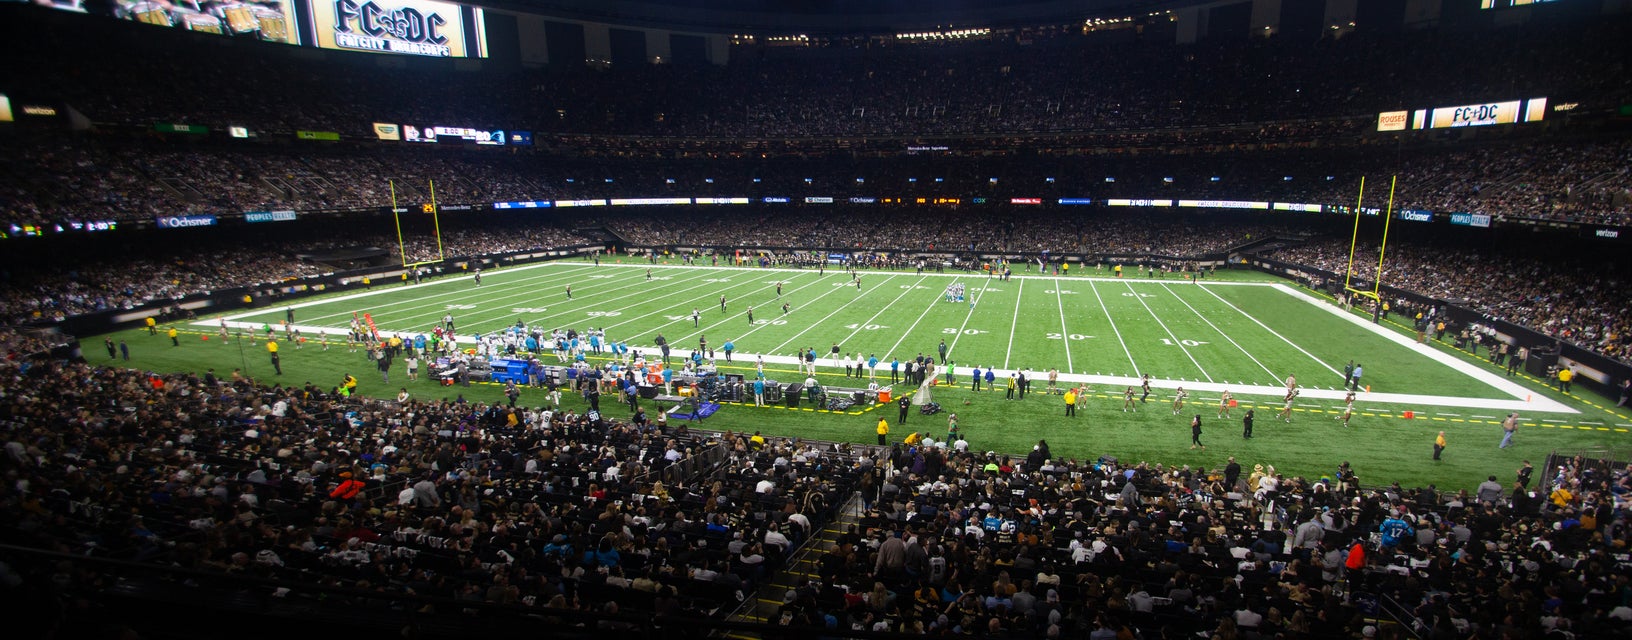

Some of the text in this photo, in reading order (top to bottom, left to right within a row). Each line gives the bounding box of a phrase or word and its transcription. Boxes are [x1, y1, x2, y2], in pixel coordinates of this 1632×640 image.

[1380, 114, 1405, 123] ROUSES
[246, 213, 272, 221] PEOPLES
[1405, 211, 1430, 222] Ochsner
[1451, 214, 1471, 225] PEOPLES
[169, 216, 212, 228] Ochsner
[1391, 528, 1403, 538] 17
